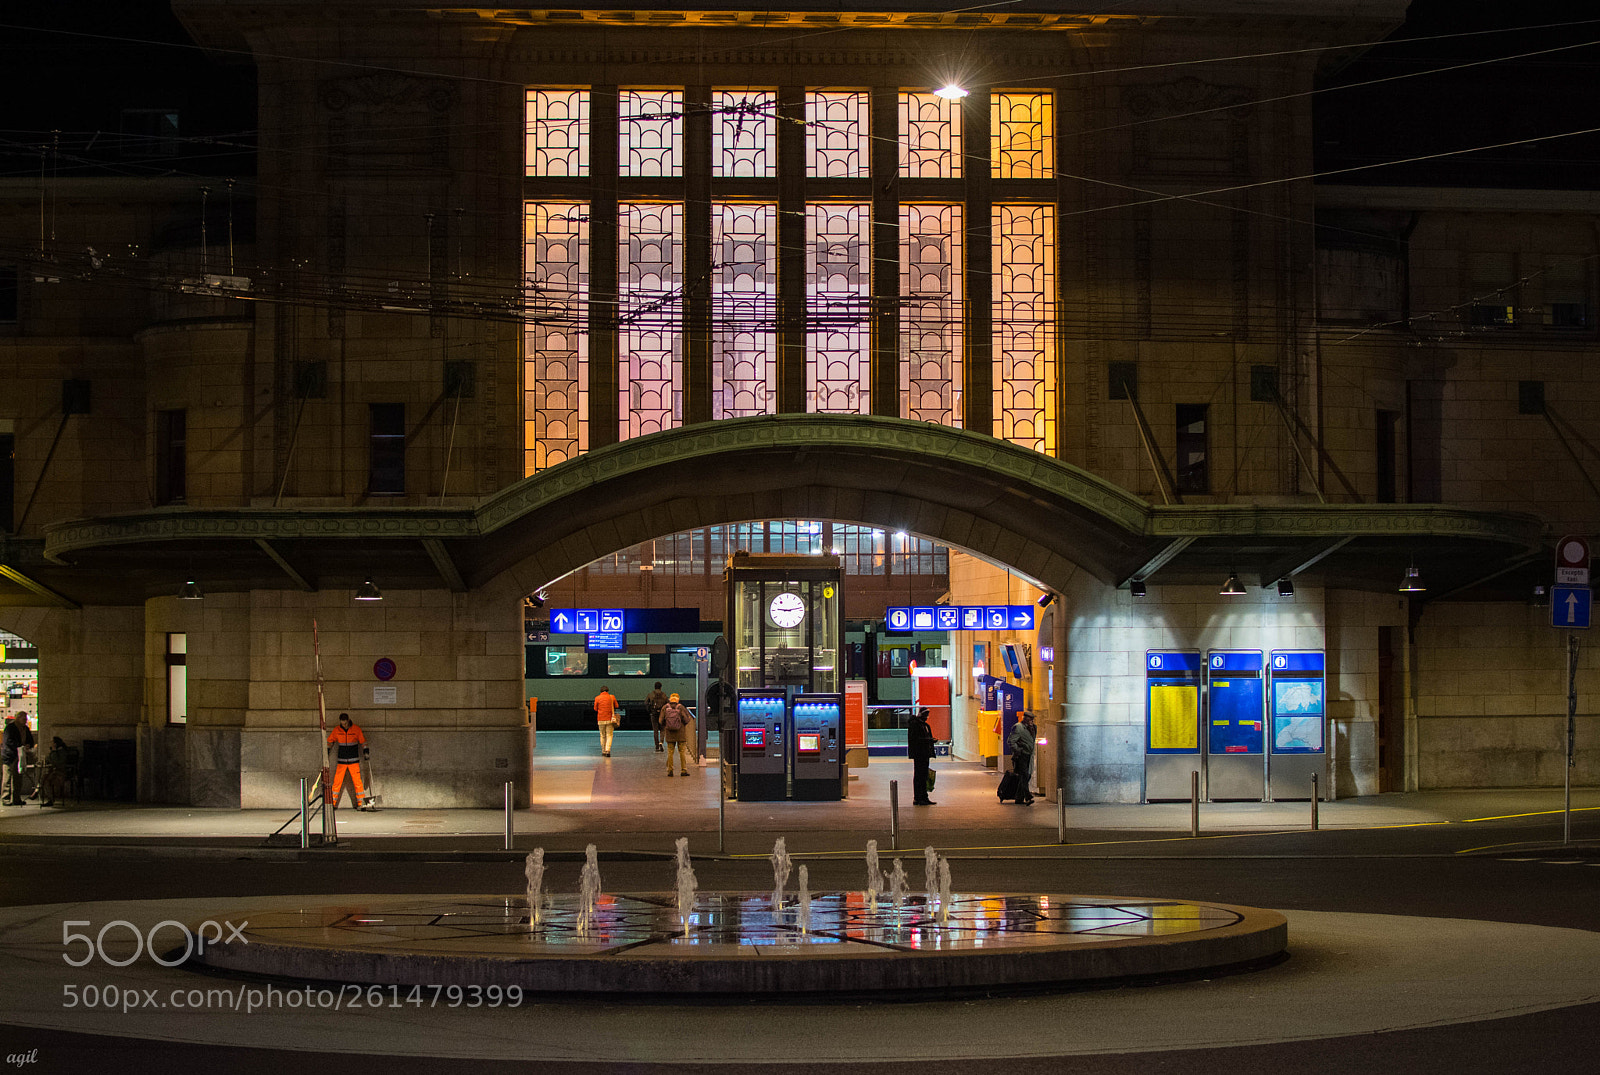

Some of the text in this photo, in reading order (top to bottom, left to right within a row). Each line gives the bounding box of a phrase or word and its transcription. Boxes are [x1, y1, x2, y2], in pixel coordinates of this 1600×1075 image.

[583, 616, 621, 629] 1 70
[992, 613, 1003, 626] 9
